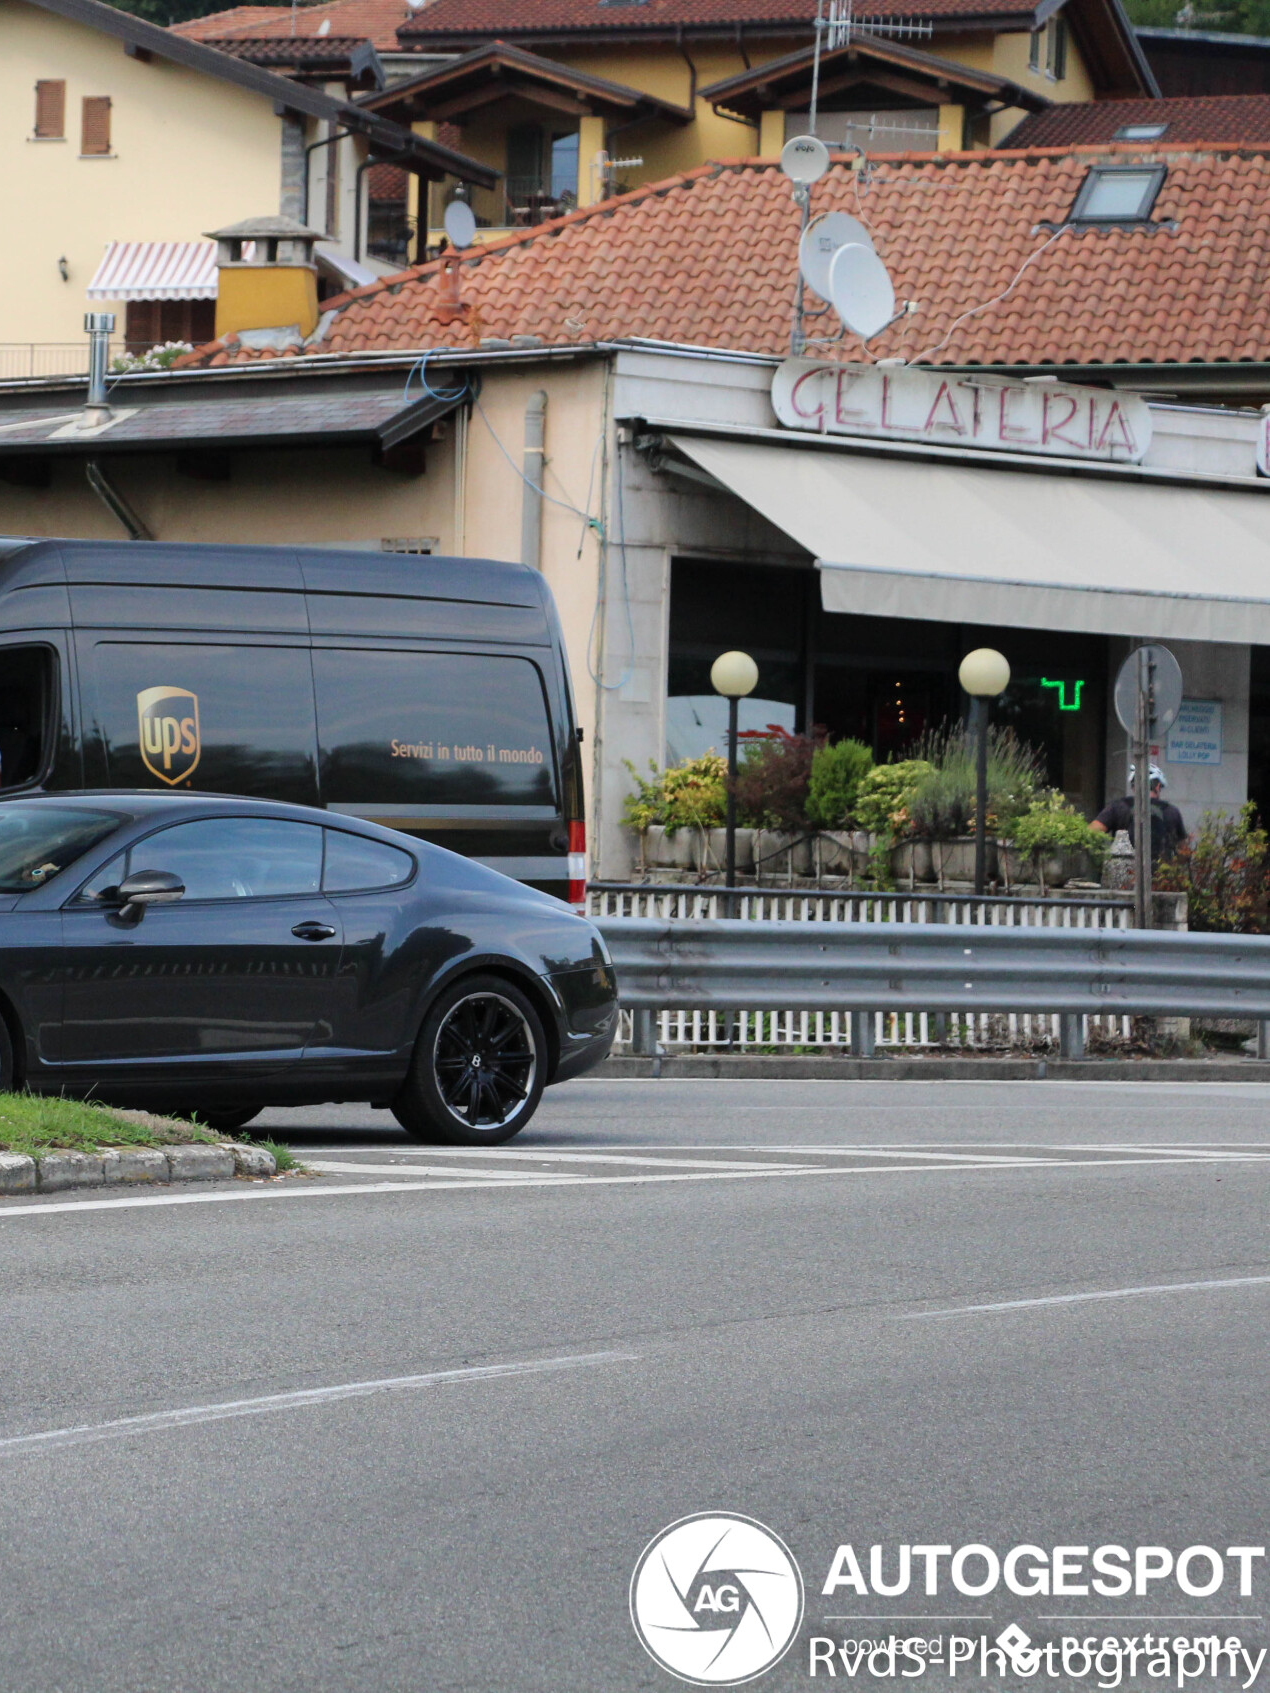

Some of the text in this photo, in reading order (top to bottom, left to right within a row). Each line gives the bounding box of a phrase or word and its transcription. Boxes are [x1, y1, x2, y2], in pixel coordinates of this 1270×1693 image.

[790, 367, 1138, 454] GELATERIA
[144, 716, 196, 769] ups
[391, 739, 543, 764] Servizi in tutto il mondo
